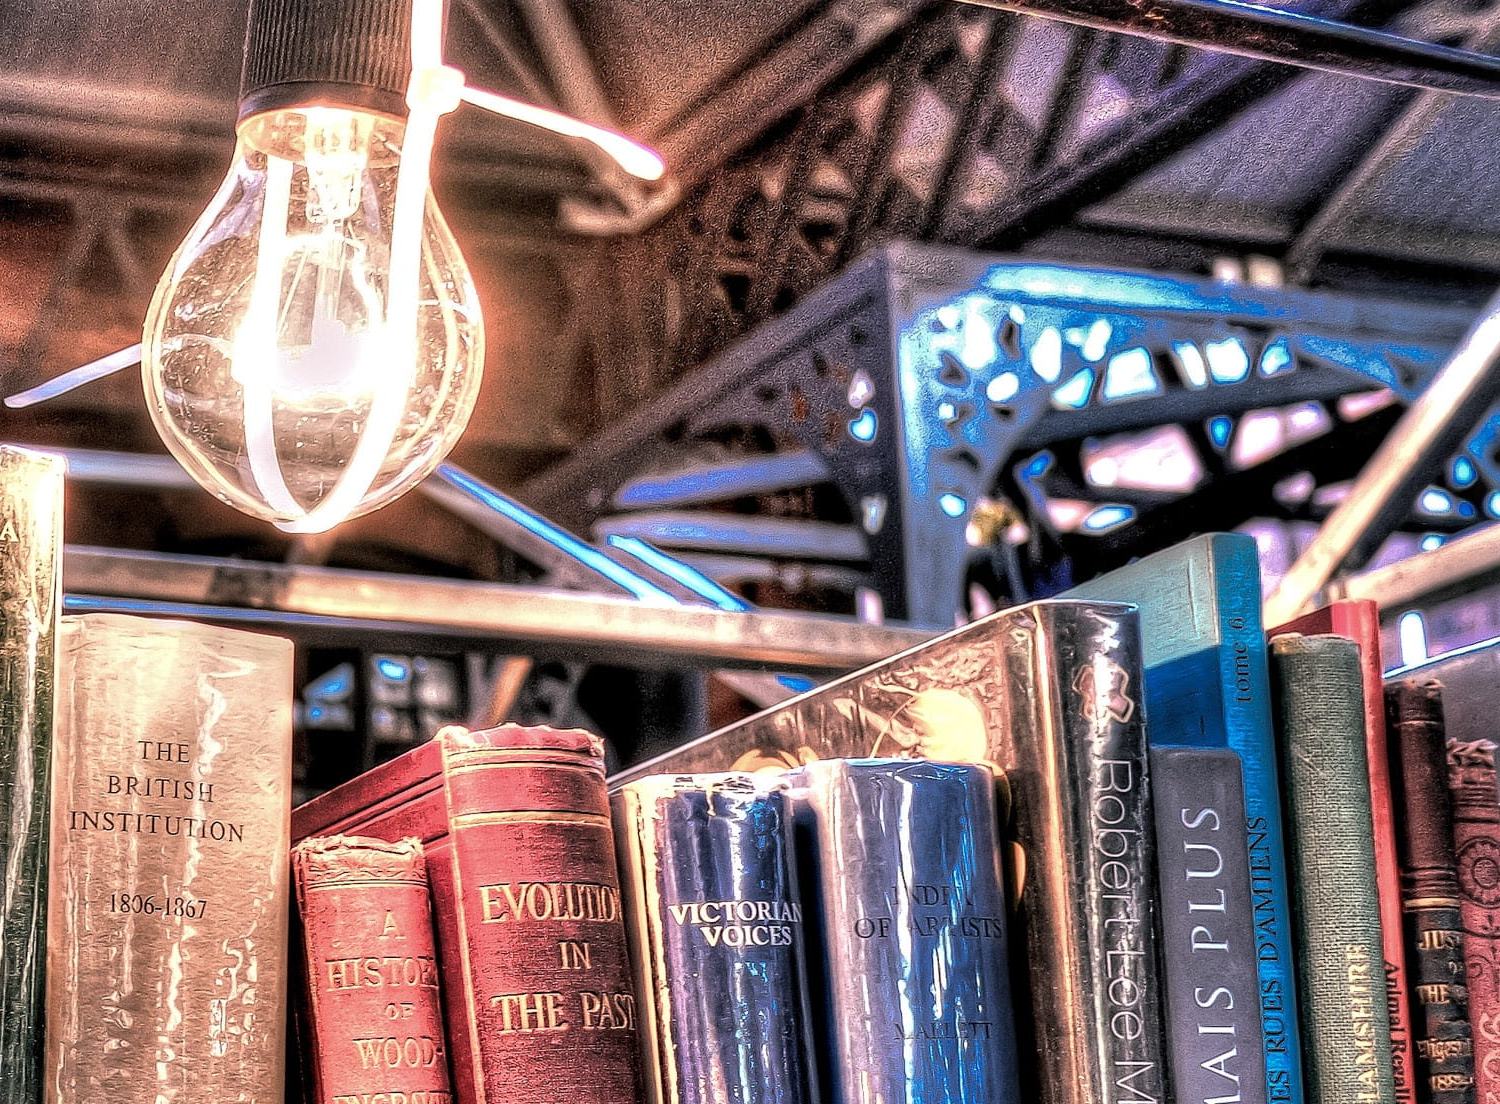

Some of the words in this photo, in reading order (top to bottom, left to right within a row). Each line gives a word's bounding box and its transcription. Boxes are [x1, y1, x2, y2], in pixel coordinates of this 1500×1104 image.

[1232, 641, 1252, 703] tome
[138, 740, 191, 763] THE
[107, 775, 214, 803] BRITISH
[69, 810, 245, 843] INSTITUTION
[1094, 758, 1140, 929] Robert
[1180, 806, 1230, 954] PLUS
[1247, 815, 1280, 964] D'AMIENS
[109, 893, 208, 919] 1806-1867
[667, 900, 802, 927] VICTORIAN
[378, 909, 406, 940] A
[700, 925, 793, 948] VOICES
[854, 917, 892, 939] OF
[558, 939, 593, 970] IN
[325, 955, 439, 993] HISTOR
[1105, 950, 1146, 1041] Lee
[489, 991, 571, 1034] THE
[578, 992, 637, 1031] PAST
[1262, 979, 1288, 1055] RUES
